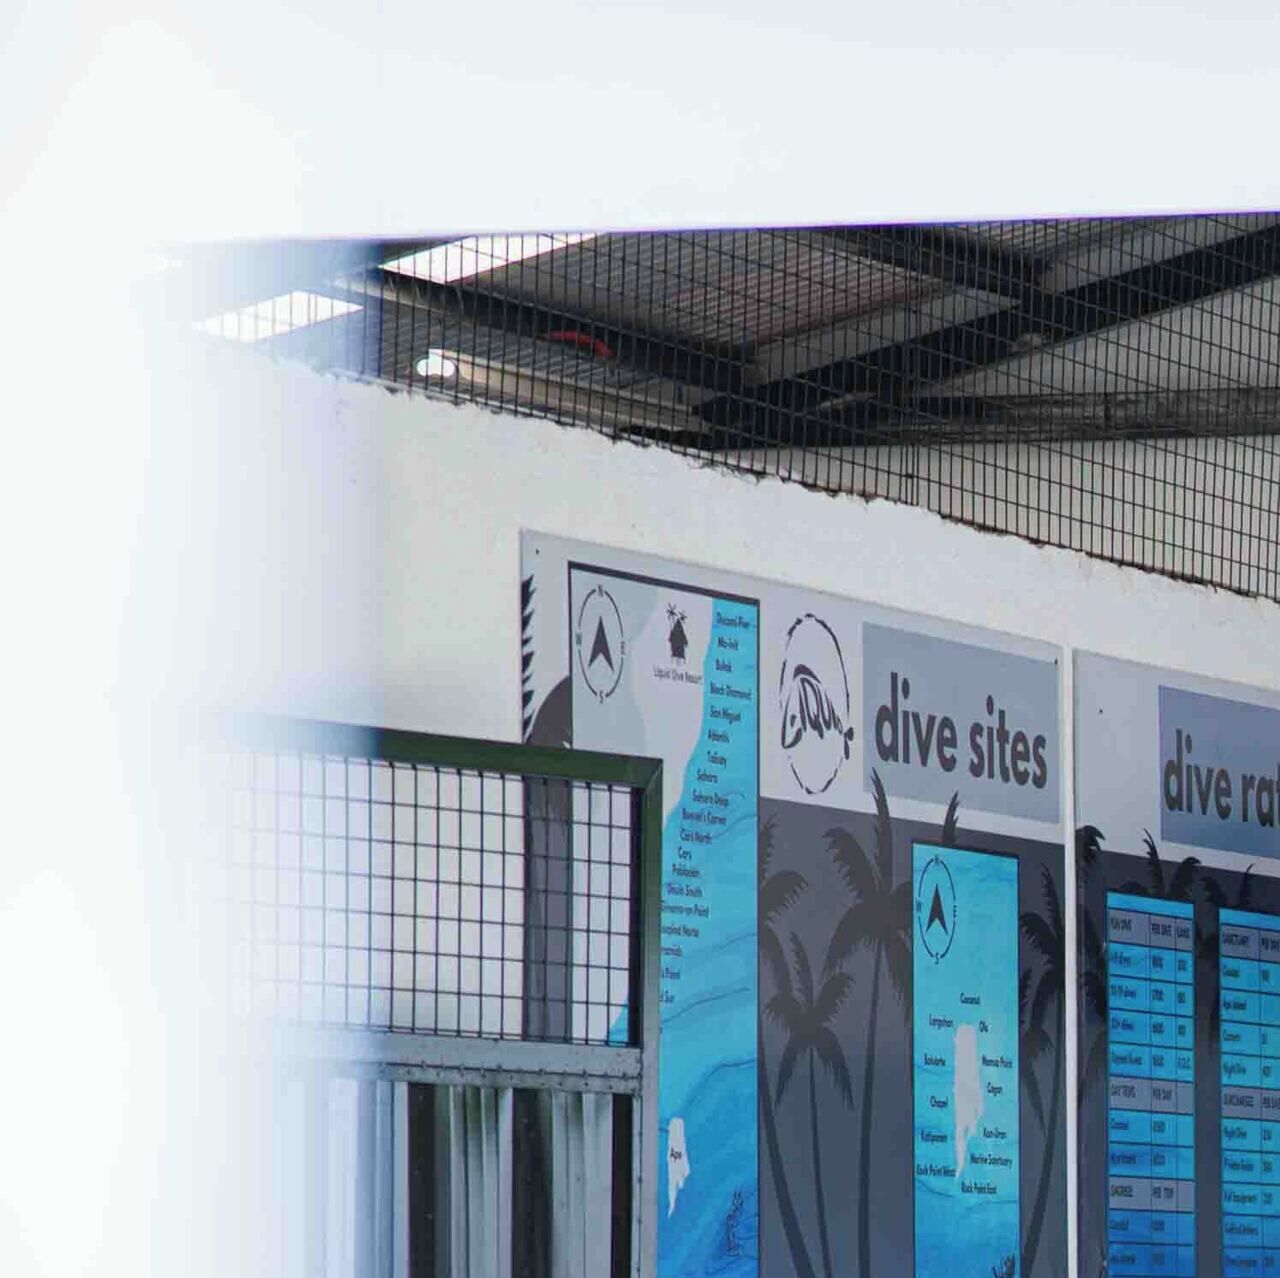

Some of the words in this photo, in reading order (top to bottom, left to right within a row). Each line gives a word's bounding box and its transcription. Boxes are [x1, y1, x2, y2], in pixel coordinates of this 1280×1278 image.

[876, 672, 958, 773] dive
[970, 694, 1048, 789] sites
[1164, 729, 1232, 820] dive
